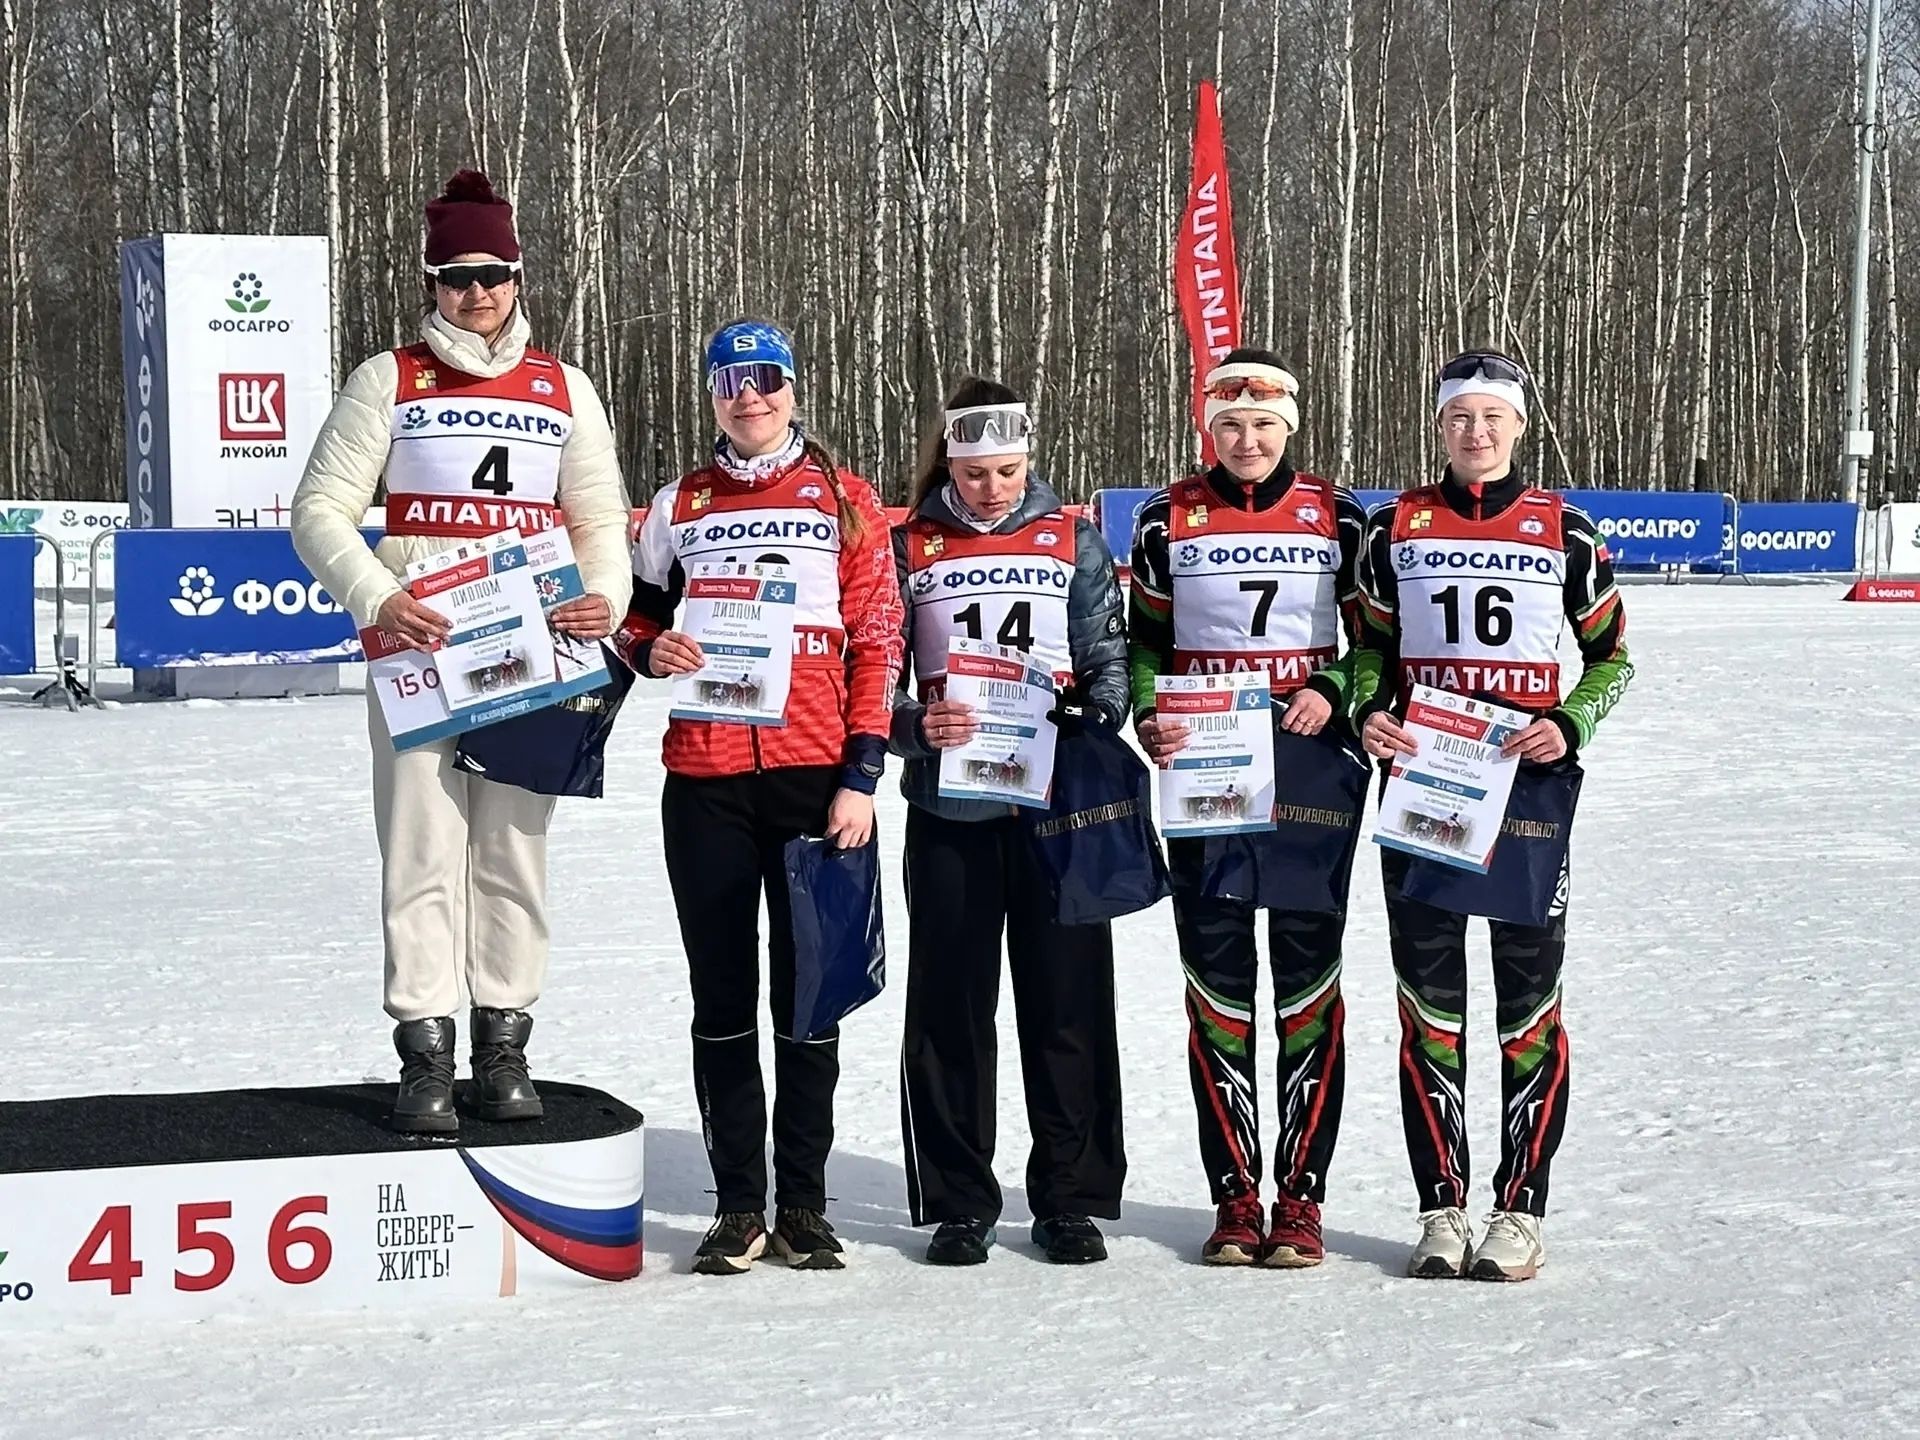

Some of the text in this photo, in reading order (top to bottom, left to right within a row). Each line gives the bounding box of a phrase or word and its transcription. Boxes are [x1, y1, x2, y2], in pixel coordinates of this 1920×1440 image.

[208, 319, 291, 332] ФОСАГРО
[437, 410, 562, 437] ФОСАГРО
[220, 445, 288, 458] ЛУКОЙЛ
[472, 445, 514, 496] 4
[404, 500, 555, 531] АПАТИТЫ
[1598, 518, 1697, 539] ФОСАГРО
[705, 521, 831, 542] ФОСАГРО
[1740, 530, 1831, 550] ФОСАГРО
[1208, 546, 1331, 565] ФОСАГРО
[1424, 551, 1552, 574] ФОСАГРО
[943, 567, 1067, 588] ФОСАГРО
[1239, 580, 1279, 637] 7
[1430, 585, 1514, 647] 16
[953, 601, 1035, 654] 14
[1406, 665, 1550, 693] АПАТИТЫ
[377, 1183, 407, 1214] НА
[68, 1195, 332, 1296] 4 5 6
[377, 1249, 451, 1282] ЖИТЬ!
